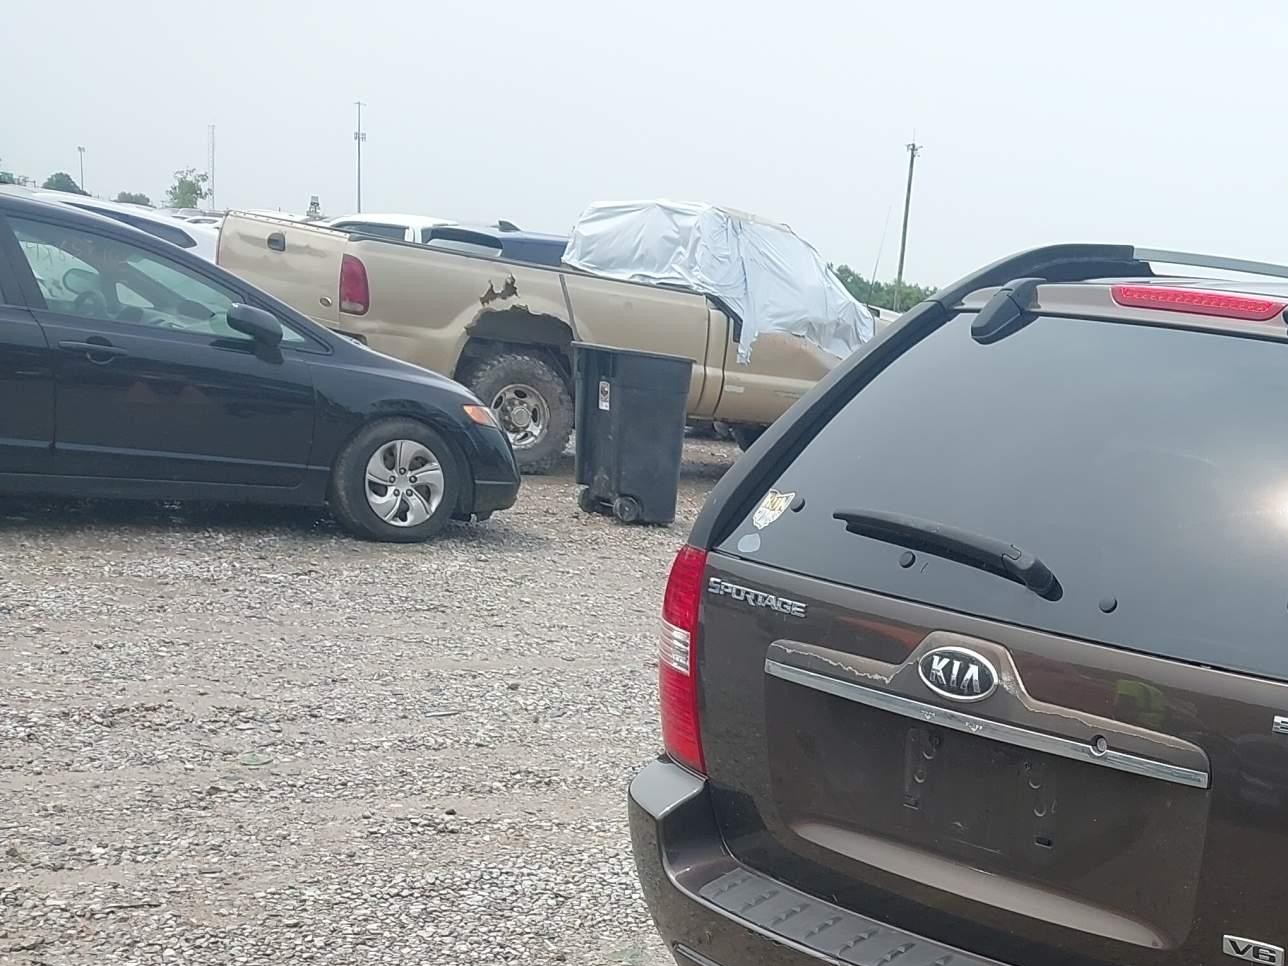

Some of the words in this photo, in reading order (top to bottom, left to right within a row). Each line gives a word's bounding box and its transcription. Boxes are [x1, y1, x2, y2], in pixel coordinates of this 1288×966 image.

[707, 577, 808, 619] SPORTAGE
[929, 655, 981, 693] KIA
[1228, 938, 1277, 963] V6
